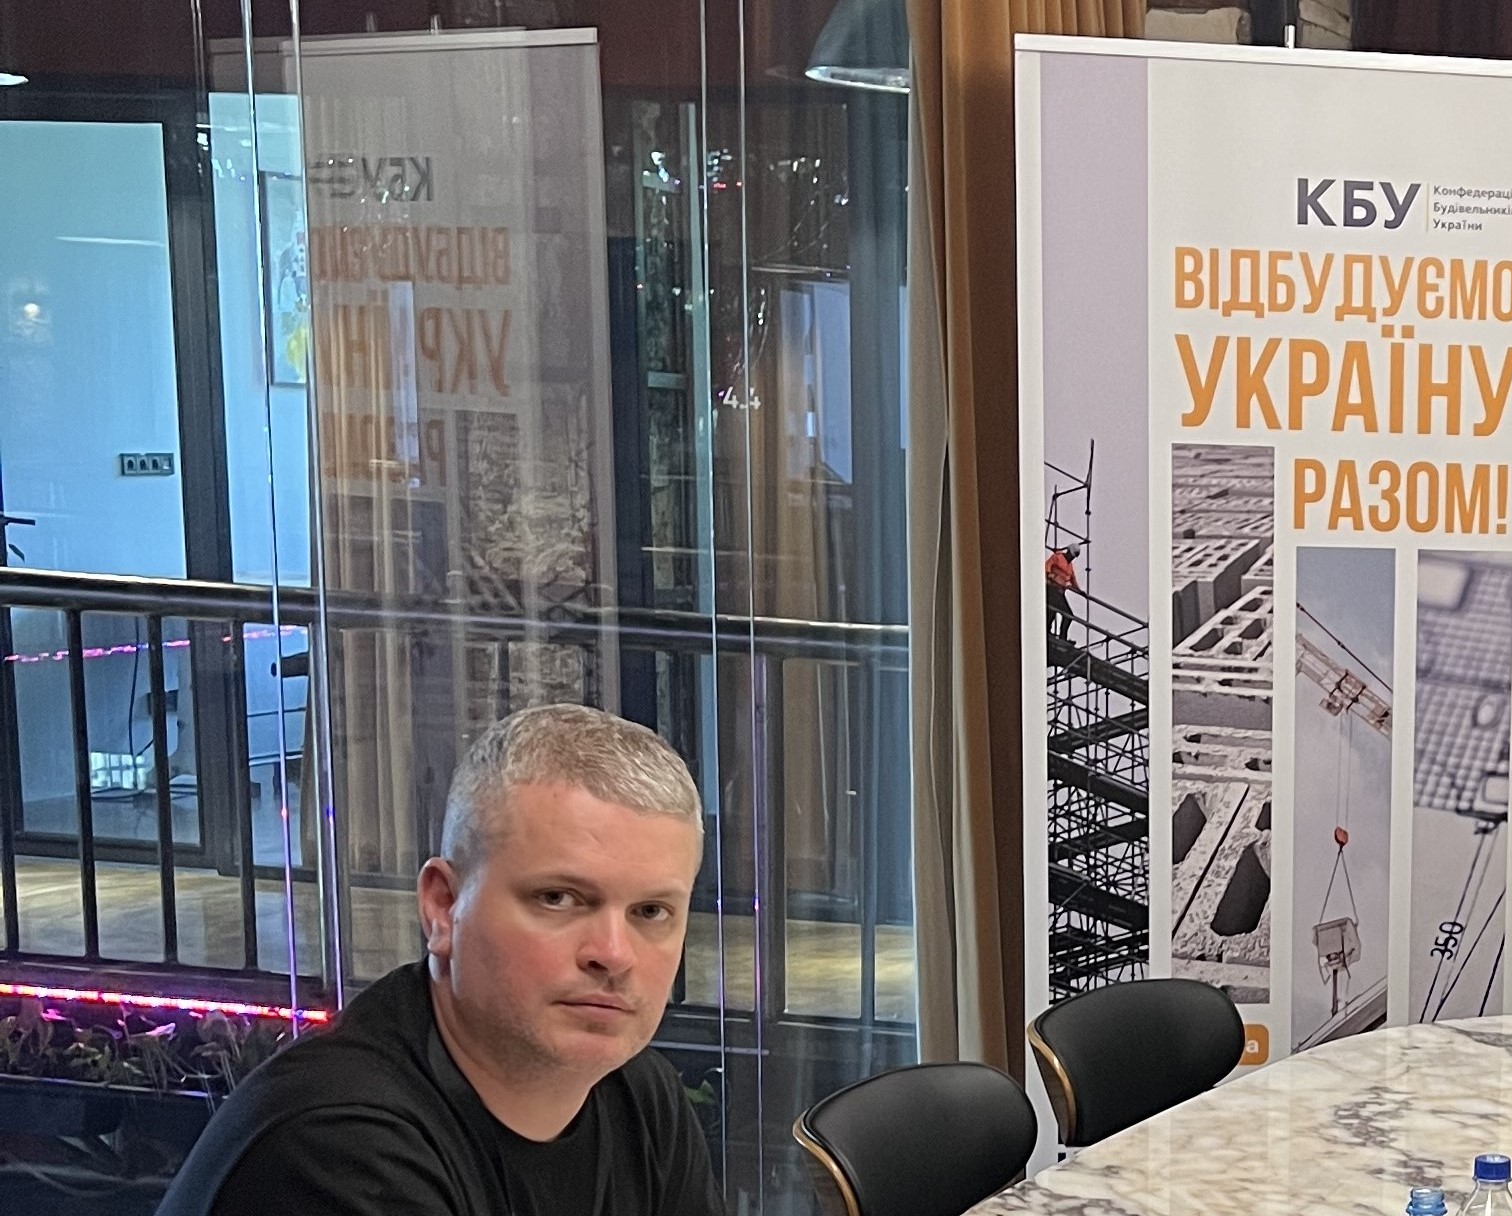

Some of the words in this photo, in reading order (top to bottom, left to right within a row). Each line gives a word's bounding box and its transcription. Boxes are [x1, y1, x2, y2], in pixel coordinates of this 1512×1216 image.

[1297, 177, 1421, 229] КБУ
[1432, 219, 1483, 232] України
[1293, 458, 1508, 534] РАЗОМ!
[1430, 921, 1465, 961] 350
